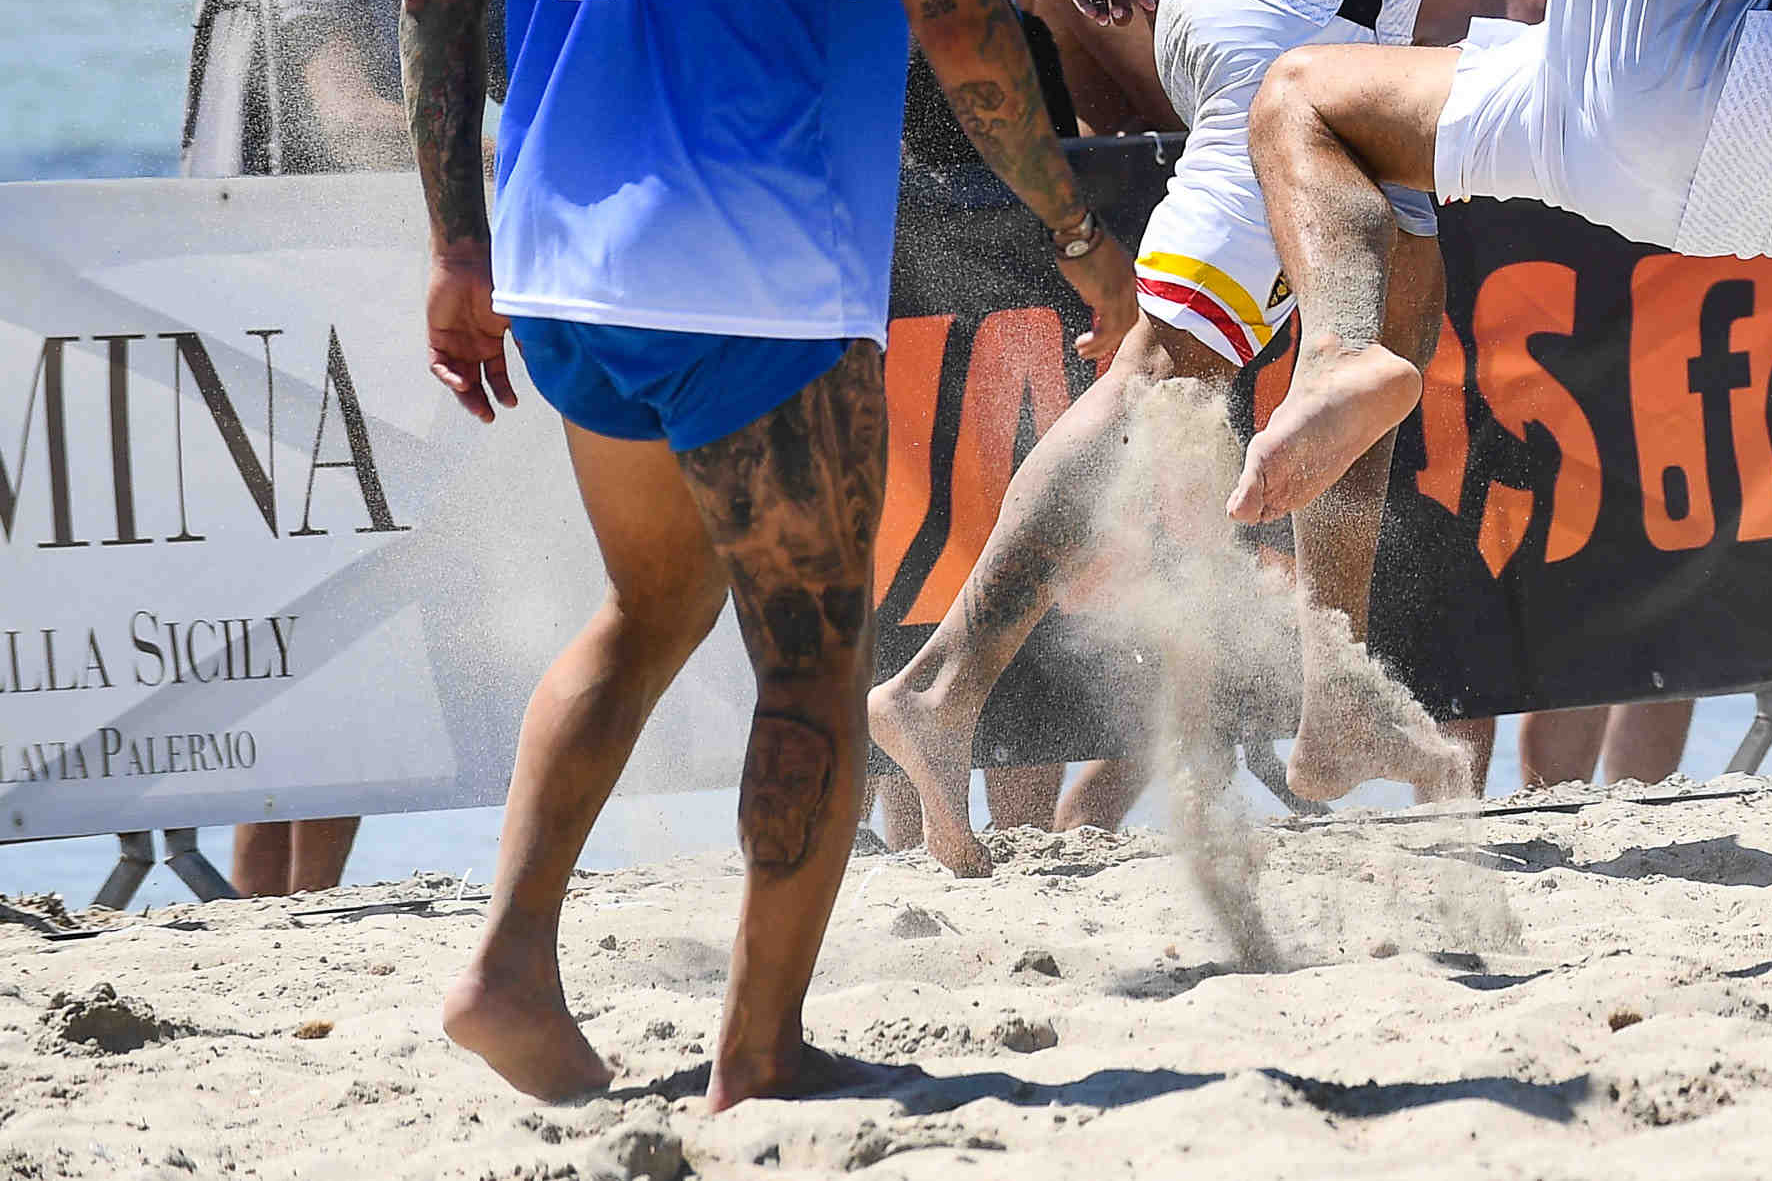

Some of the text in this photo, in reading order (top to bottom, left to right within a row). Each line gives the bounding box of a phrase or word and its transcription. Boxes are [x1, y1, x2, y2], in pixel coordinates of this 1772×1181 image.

[0, 610, 299, 693] LLA SICILY
[97, 727, 257, 778] PALERMO
